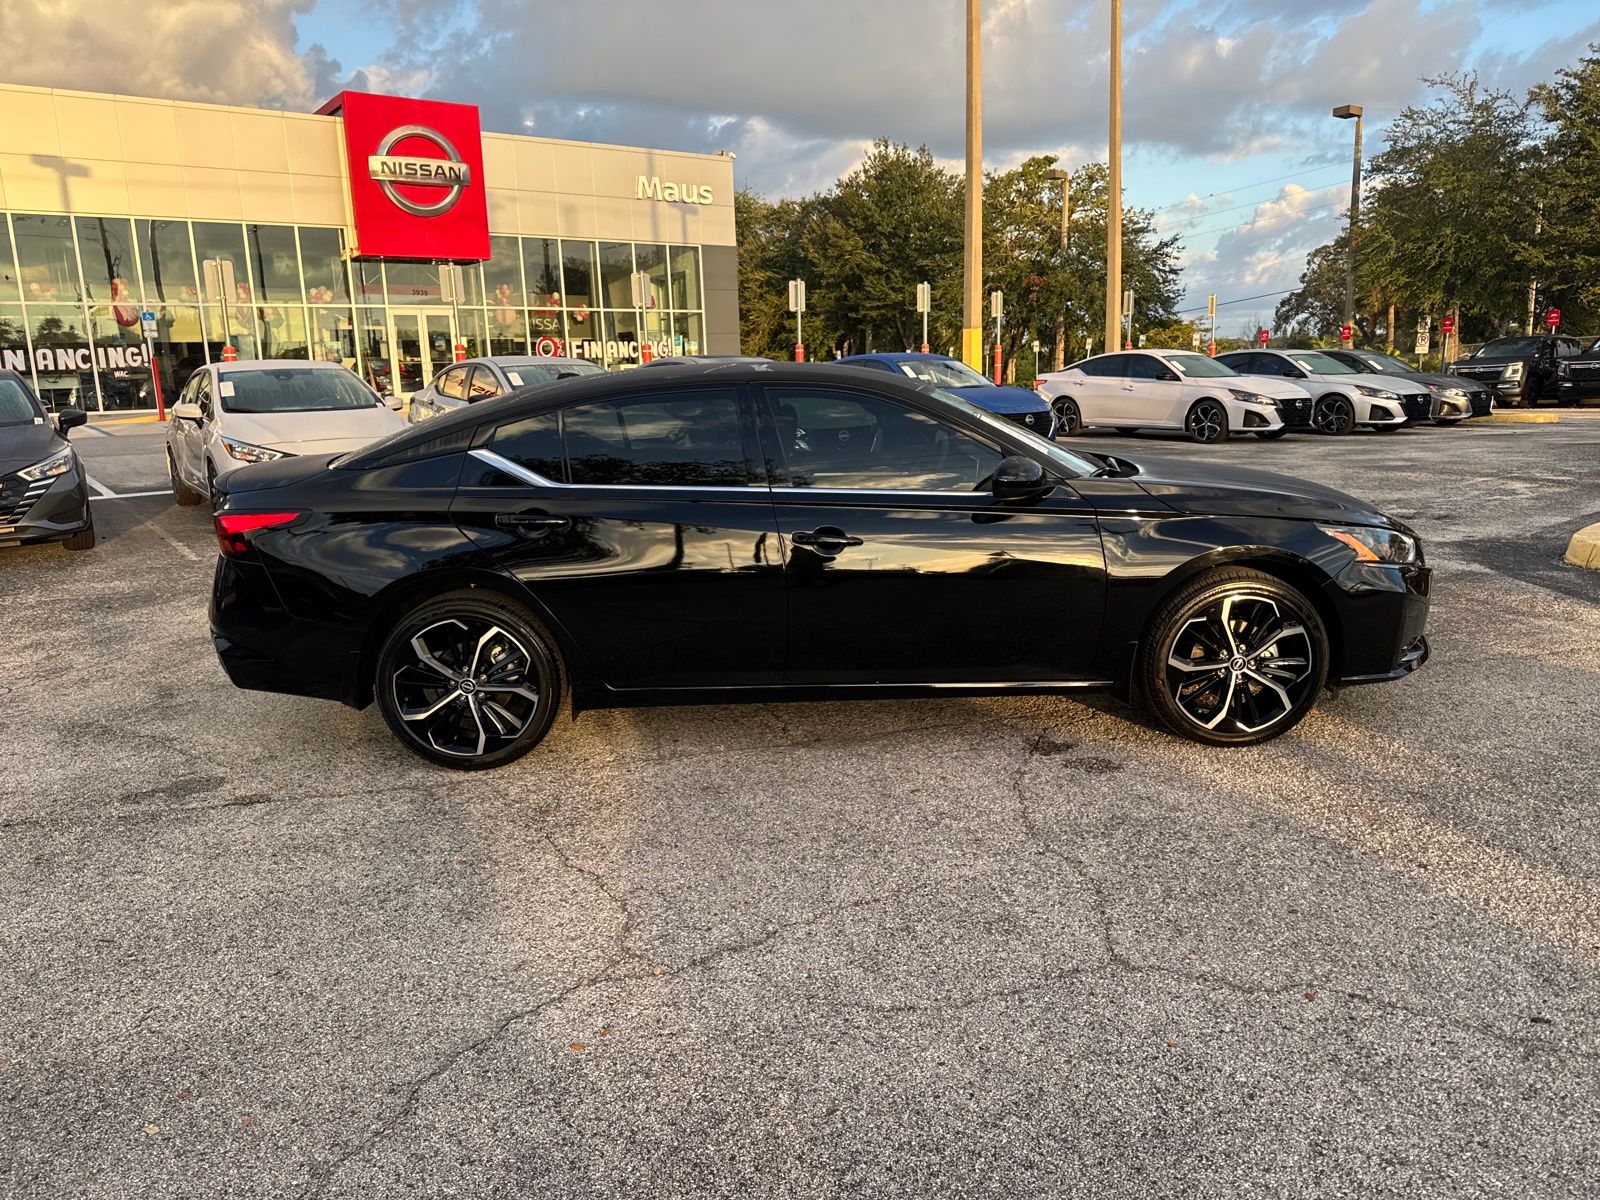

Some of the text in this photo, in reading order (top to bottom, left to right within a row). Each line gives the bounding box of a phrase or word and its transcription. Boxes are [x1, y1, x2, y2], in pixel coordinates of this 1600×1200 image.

[380, 161, 462, 181] NISSAN
[636, 175, 714, 205] Maus
[411, 289, 429, 297] 3939
[0, 343, 149, 371] NANCING!
